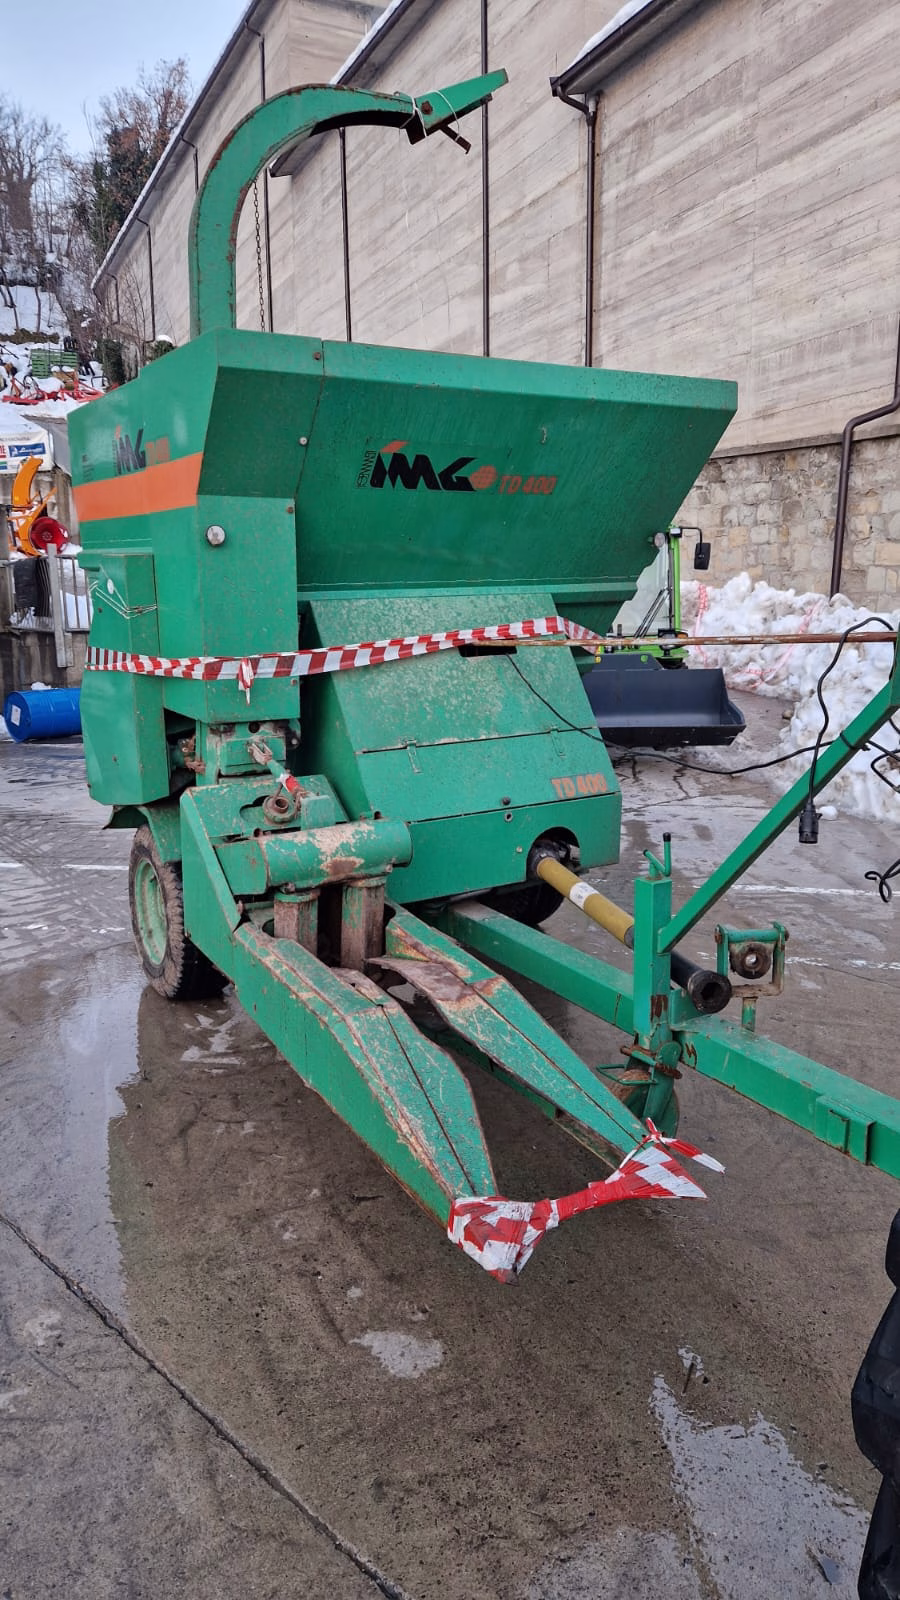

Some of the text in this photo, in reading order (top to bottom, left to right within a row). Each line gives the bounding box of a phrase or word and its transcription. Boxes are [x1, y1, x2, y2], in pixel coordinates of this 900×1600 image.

[499, 475, 520, 494] TD
[521, 476, 557, 495] 400
[551, 773, 607, 799] TD 400
